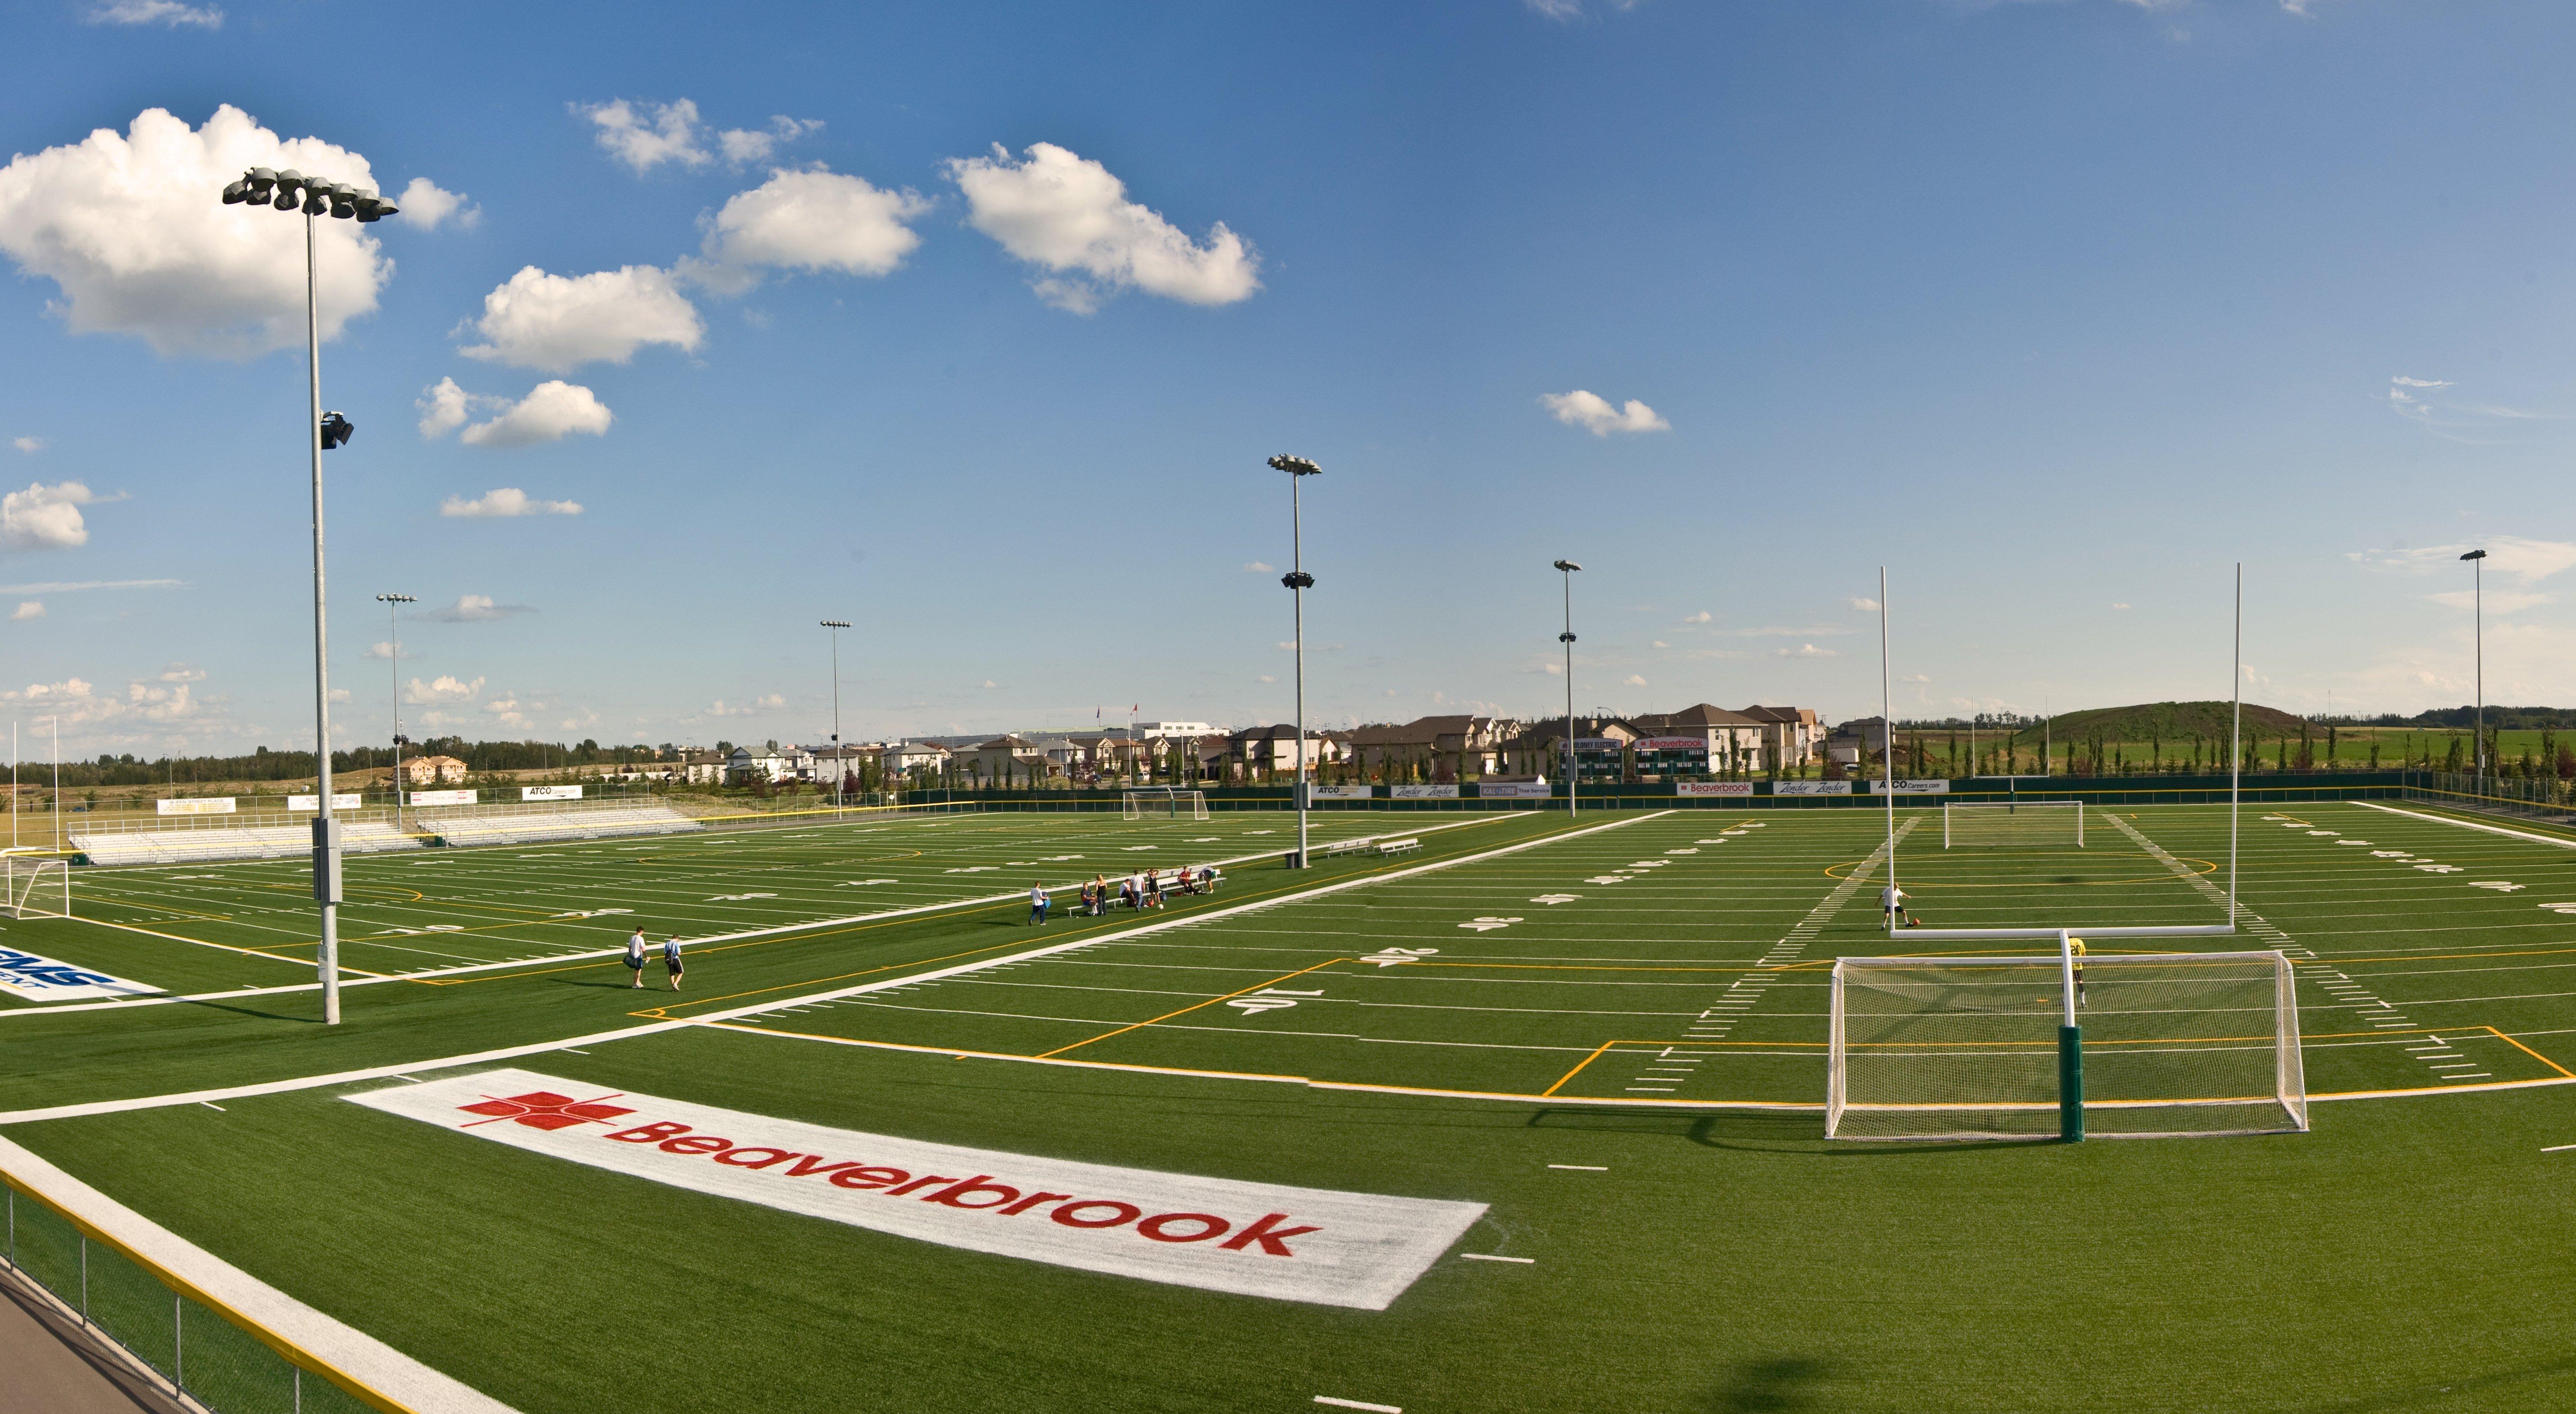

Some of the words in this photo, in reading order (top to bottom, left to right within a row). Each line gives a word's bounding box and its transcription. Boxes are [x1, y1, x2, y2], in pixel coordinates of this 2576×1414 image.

[1650, 739, 1703, 747] Beaverbrook
[1691, 783, 1749, 792] Beaverbrook
[1779, 782, 1810, 794] Zender
[1815, 782, 1846, 794] Zender
[1878, 781, 1907, 789] ACO
[1396, 786, 1422, 797] Zender
[1427, 786, 1454, 797] Zender
[1360, 947, 1440, 962] 20
[2070, 945, 2081, 955] 20
[1226, 988, 1326, 1009] 10
[604, 1120, 1324, 1257] Beaverbrook
